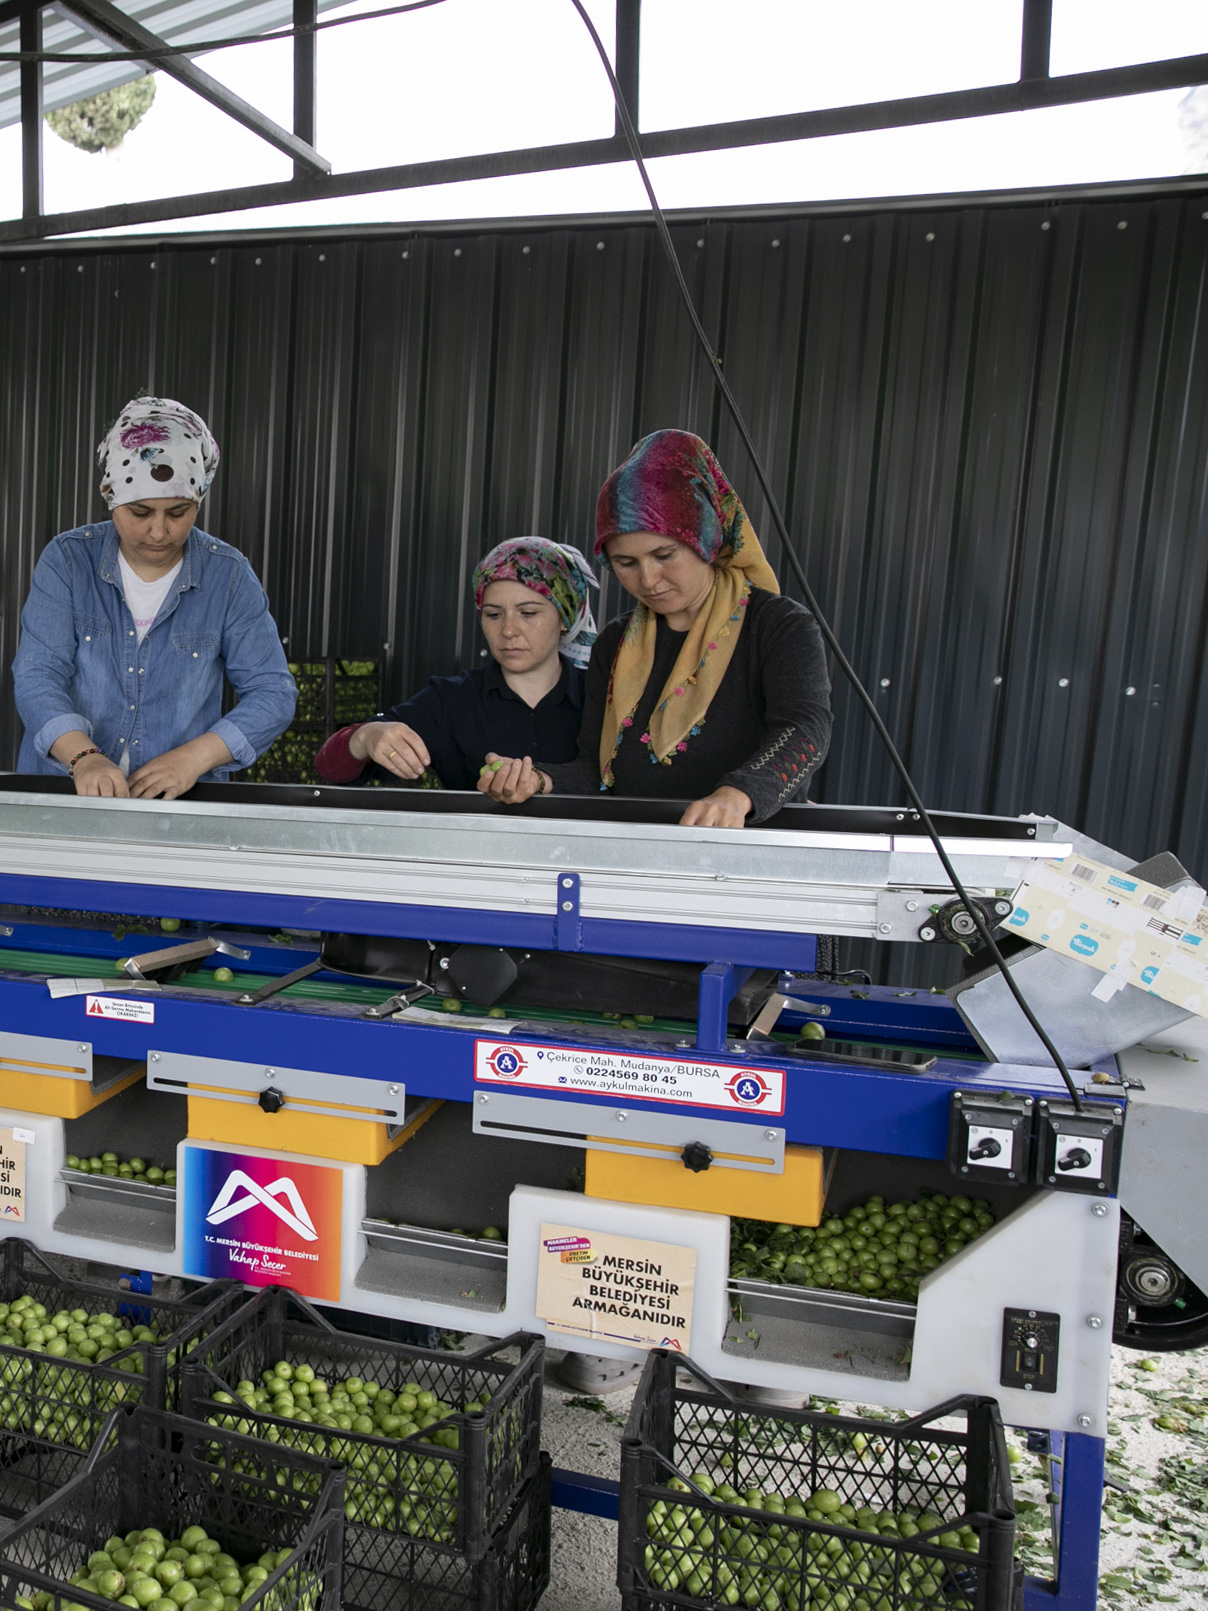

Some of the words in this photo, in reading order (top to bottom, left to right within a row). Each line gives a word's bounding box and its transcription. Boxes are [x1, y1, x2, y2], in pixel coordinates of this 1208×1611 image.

[500, 1056, 514, 1070] A
[546, 1052, 587, 1064] Çekrice
[590, 1056, 617, 1067] Mah.
[620, 1059, 721, 1079] Mudanya/BURSA
[586, 1066, 639, 1081] 0224569
[642, 1072, 658, 1083] 80
[661, 1074, 677, 1085] 45
[570, 1077, 693, 1098] www.aykulmakina.com
[740, 1082, 755, 1097] A
[204, 1235, 216, 1244] T.C.
[216, 1237, 241, 1248] MERSİN
[241, 1241, 283, 1256] BÜYÜKŞEHİR
[283, 1250, 319, 1262] BELEDİYESİ
[228, 1248, 259, 1271] Vahap
[261, 1254, 287, 1271] Seçer
[602, 1255, 662, 1276] MERSİN
[582, 1265, 680, 1296] BÜYÜKŞEHİR
[589, 1284, 671, 1310] BELEDİYESİ
[572, 1296, 686, 1329] ARMAĞANIDIR
